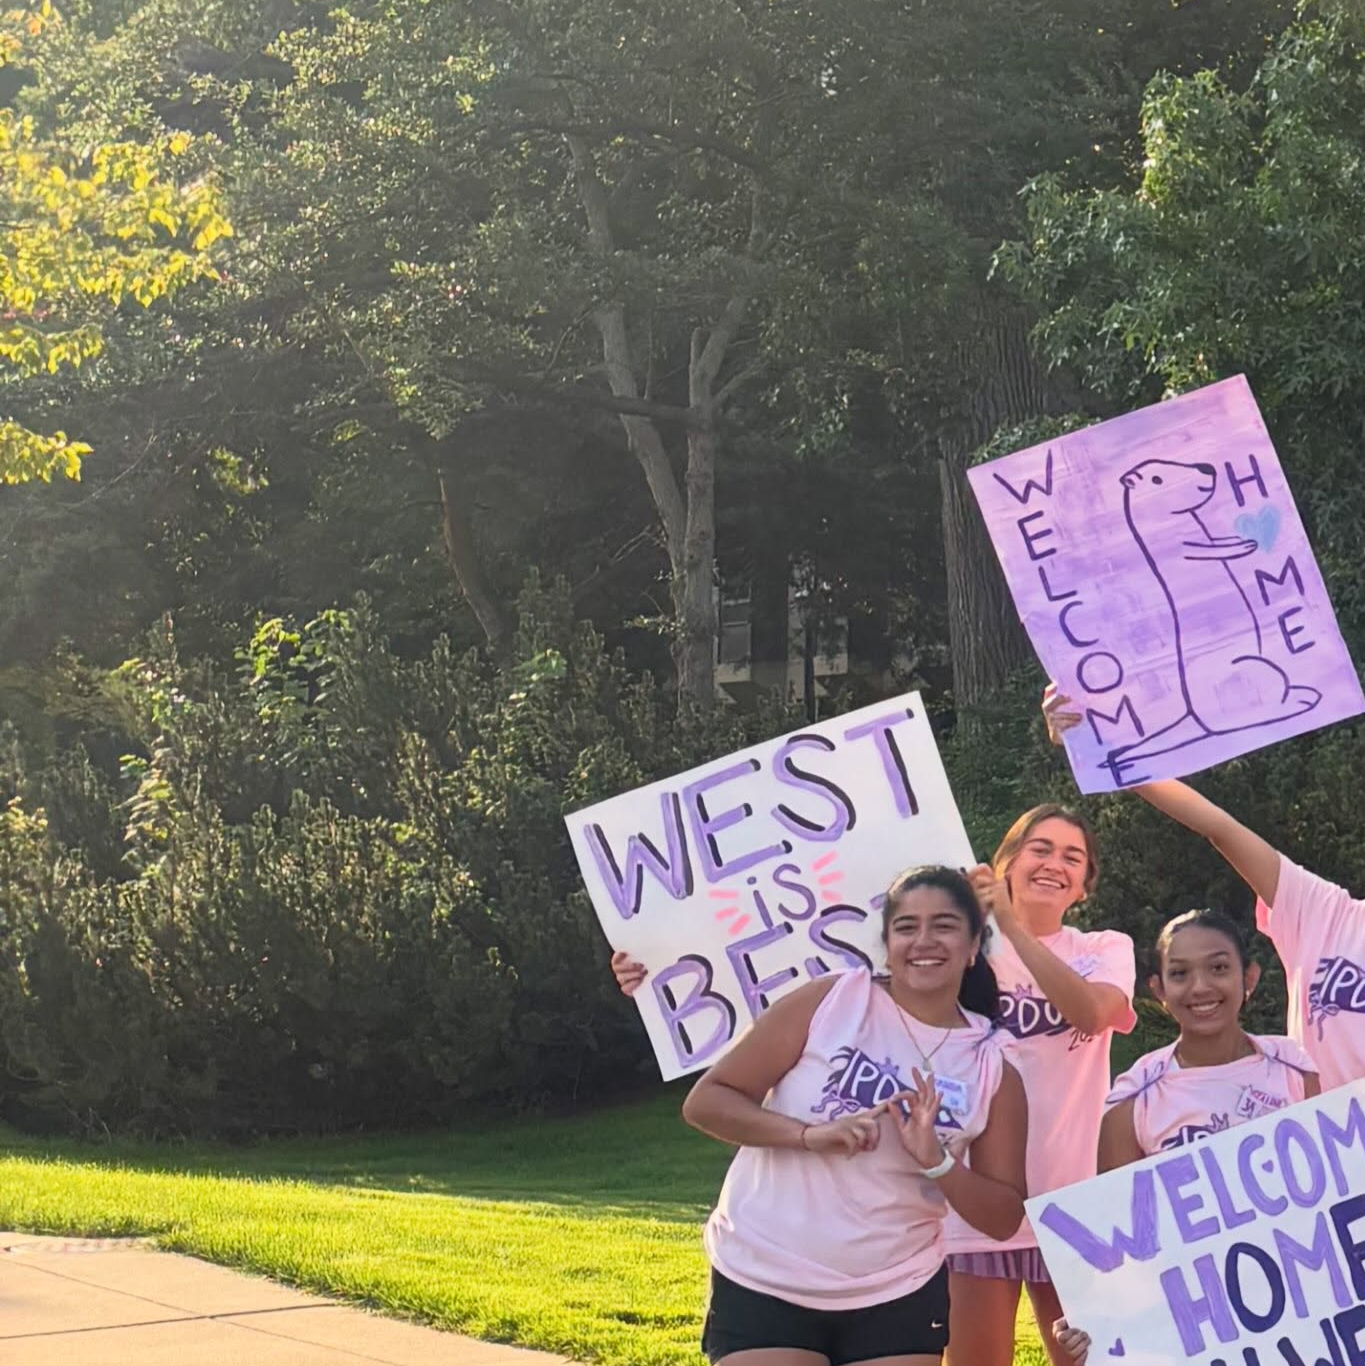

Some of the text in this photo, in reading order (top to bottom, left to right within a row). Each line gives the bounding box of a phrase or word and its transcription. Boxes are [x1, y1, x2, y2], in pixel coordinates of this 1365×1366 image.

[993, 448, 1151, 787] WELCOME
[583, 707, 919, 920] WEST
[745, 863, 817, 930] is
[651, 893, 891, 1069] BES
